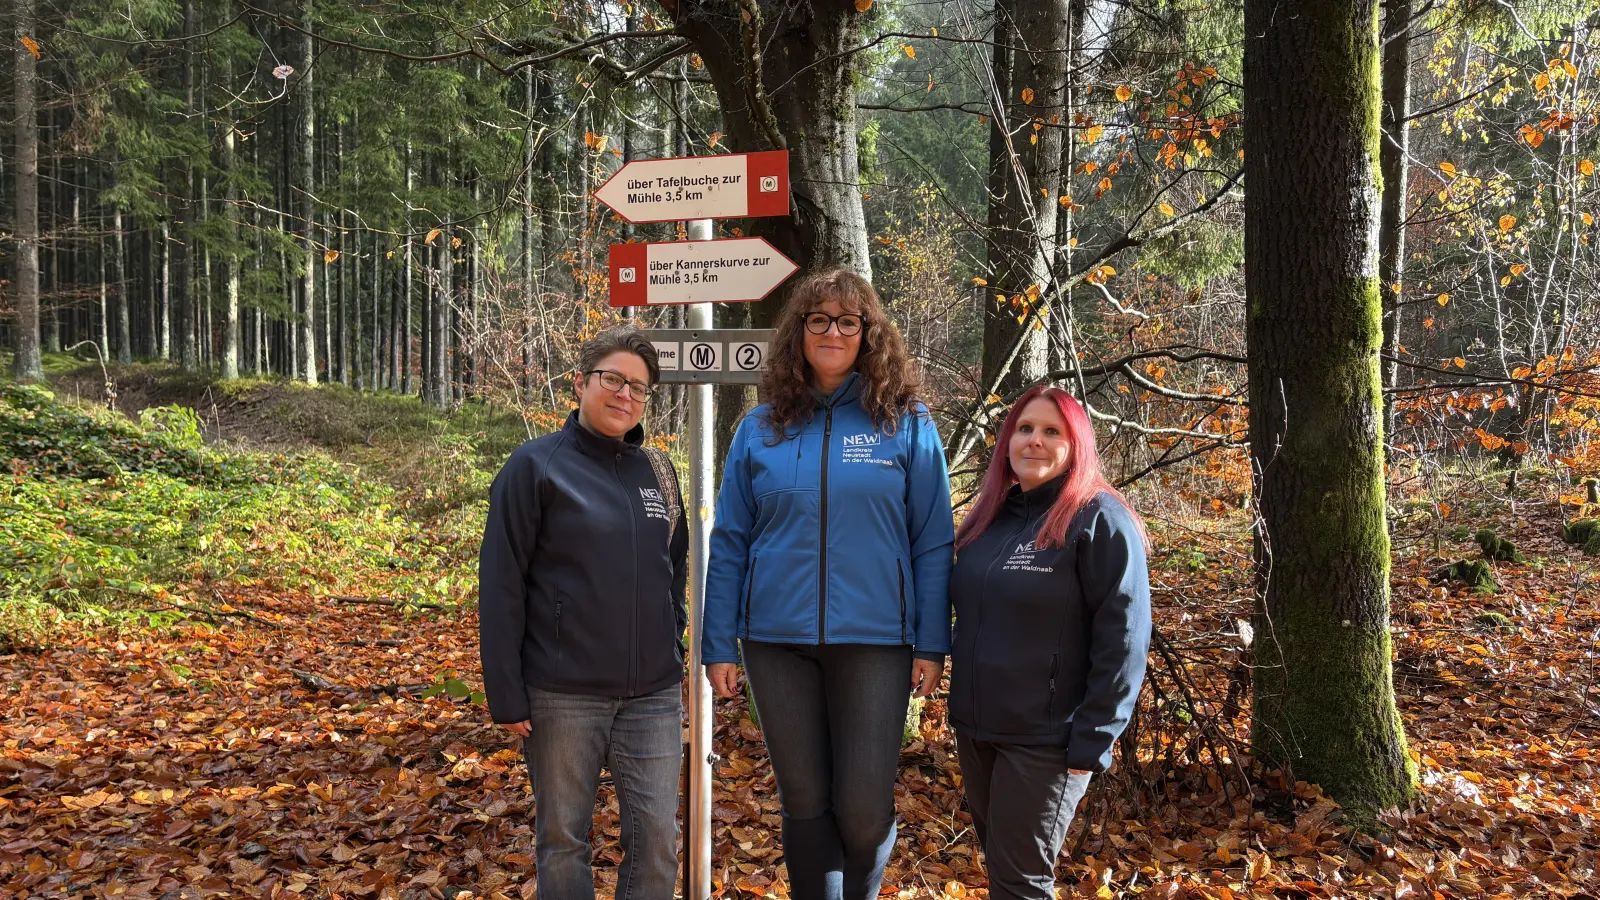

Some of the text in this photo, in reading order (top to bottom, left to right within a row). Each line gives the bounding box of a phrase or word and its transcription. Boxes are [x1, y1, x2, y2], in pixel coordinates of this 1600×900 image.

[627, 174, 741, 190] über Tafelbuche zur
[627, 190, 703, 204] Mühle 3,5 km
[649, 256, 770, 271] über Kannerskurve zur
[649, 272, 718, 285] Mühle 3,5 km
[657, 348, 676, 359] lme
[696, 347, 709, 366] M
[743, 347, 755, 365] 2
[843, 433, 878, 446] NEW
[1021, 565, 1054, 573] Waldnaab
